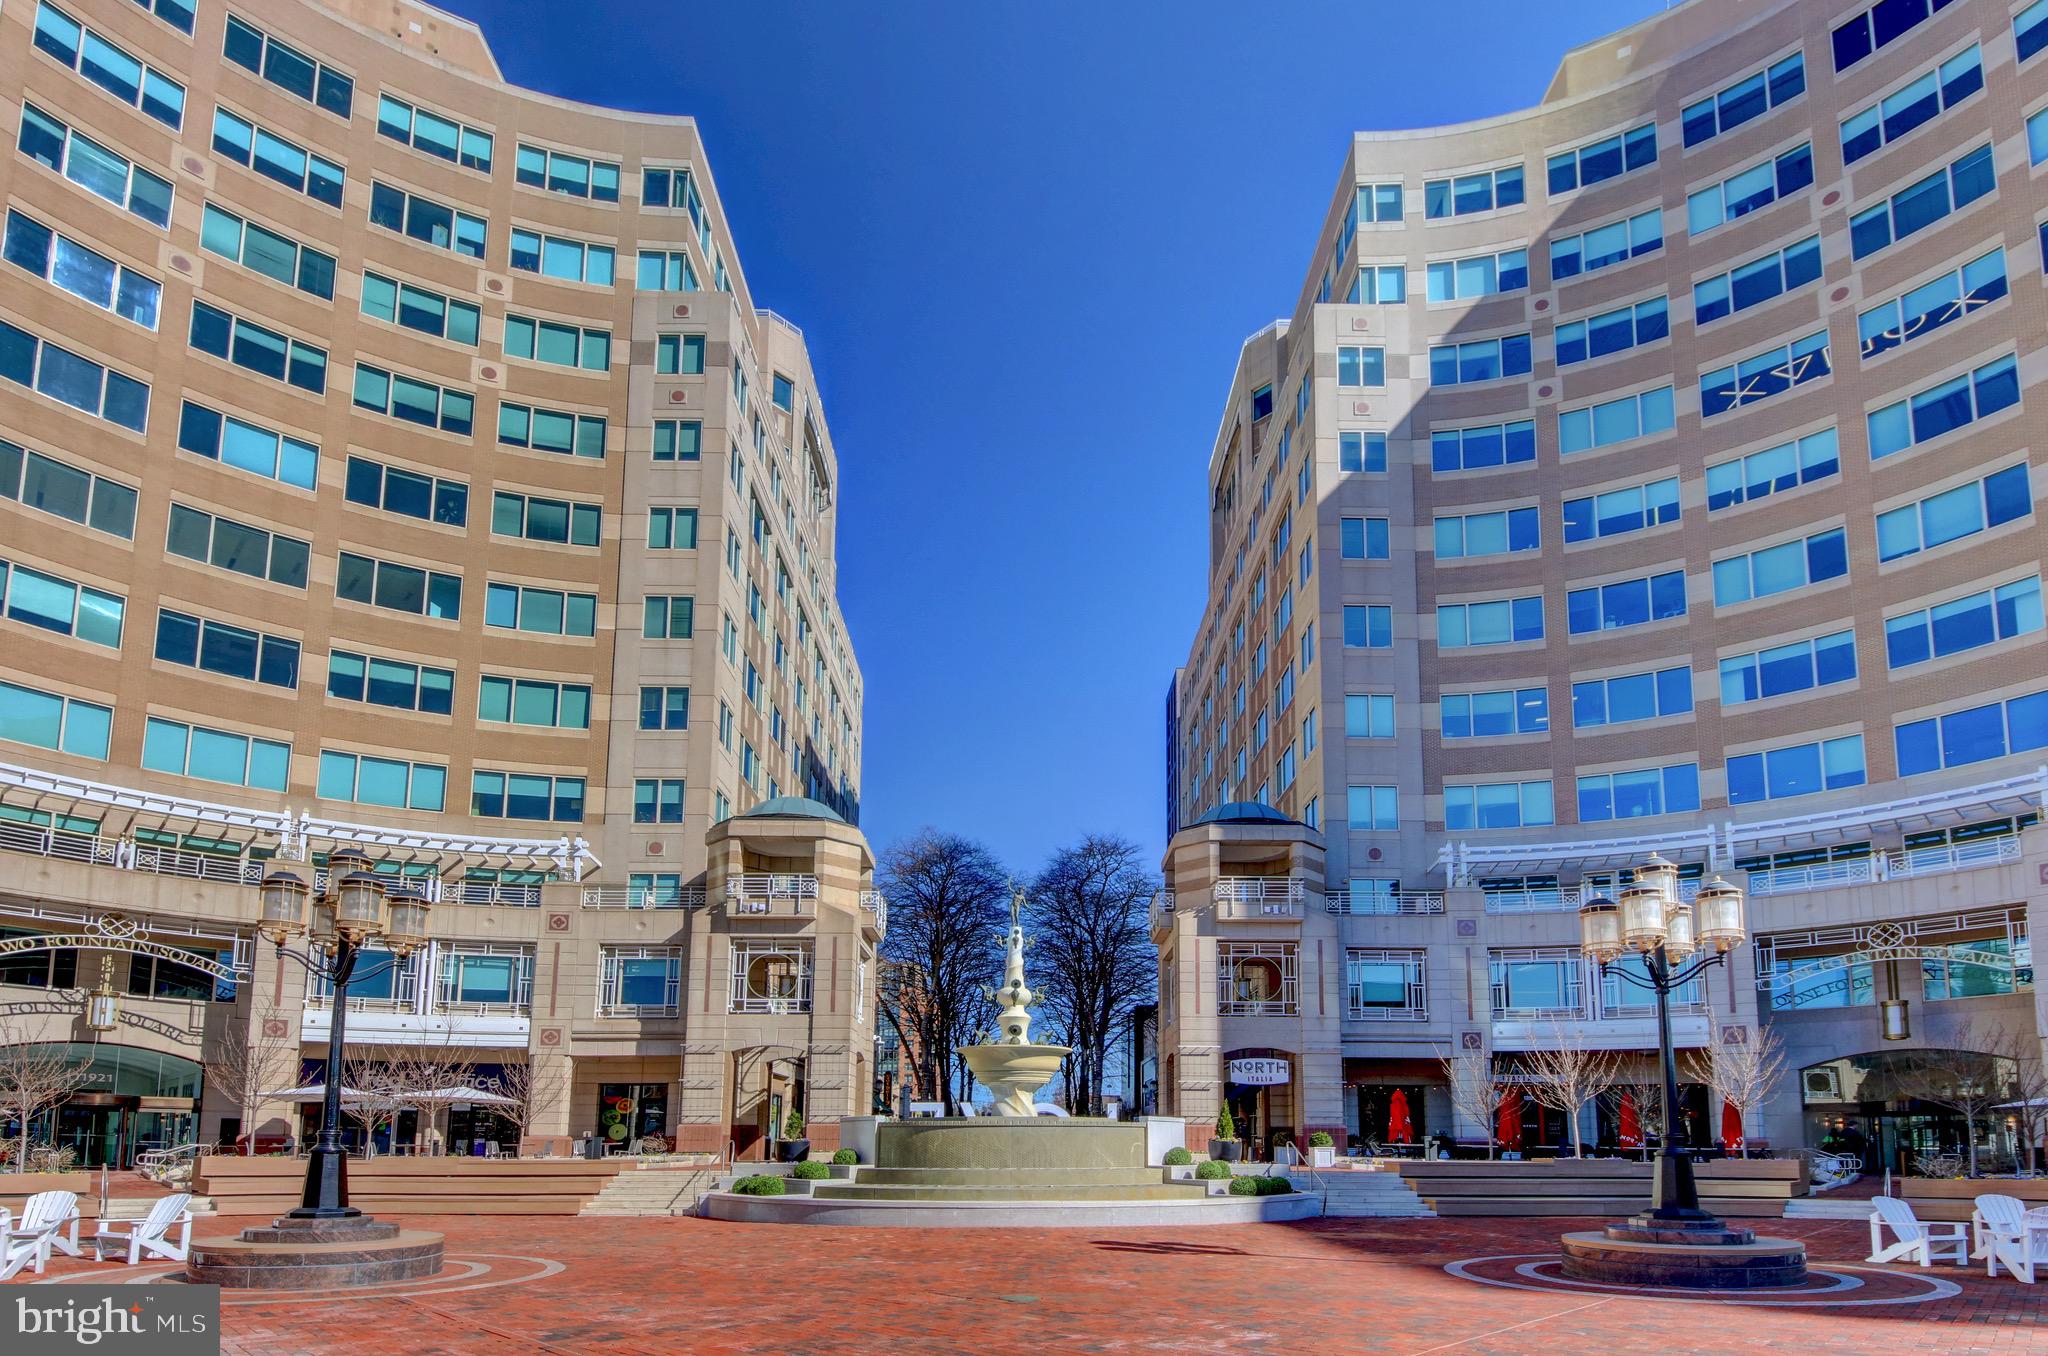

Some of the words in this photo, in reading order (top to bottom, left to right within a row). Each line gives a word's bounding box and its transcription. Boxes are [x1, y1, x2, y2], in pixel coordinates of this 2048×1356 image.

[0, 938, 36, 952] WO
[45, 936, 152, 953] FOUNTAIN
[160, 946, 231, 978] SQUARE
[1231, 1061, 1287, 1074] NORTH
